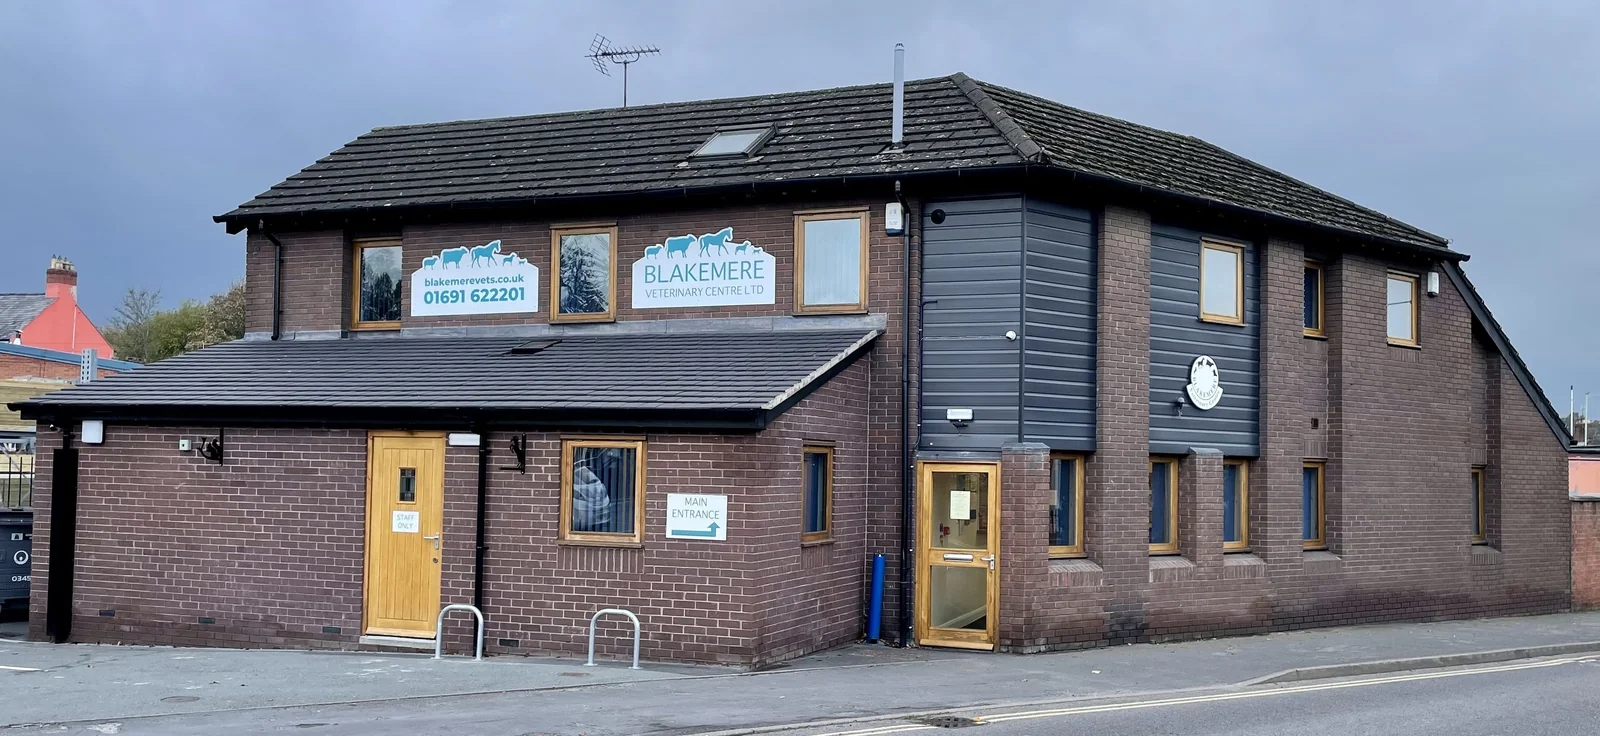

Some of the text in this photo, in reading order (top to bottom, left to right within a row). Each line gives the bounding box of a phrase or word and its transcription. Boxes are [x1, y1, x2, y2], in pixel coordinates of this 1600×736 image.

[644, 260, 765, 284] BLAKEMERE
[424, 274, 524, 287] blakemerevets.co.uk
[423, 287, 525, 305] 01691 622201
[645, 284, 764, 299] VETERINARY CENTRE LTD
[684, 497, 708, 507] MAIN
[671, 508, 720, 520] ENTRANCE
[397, 522, 414, 530] ONLY
